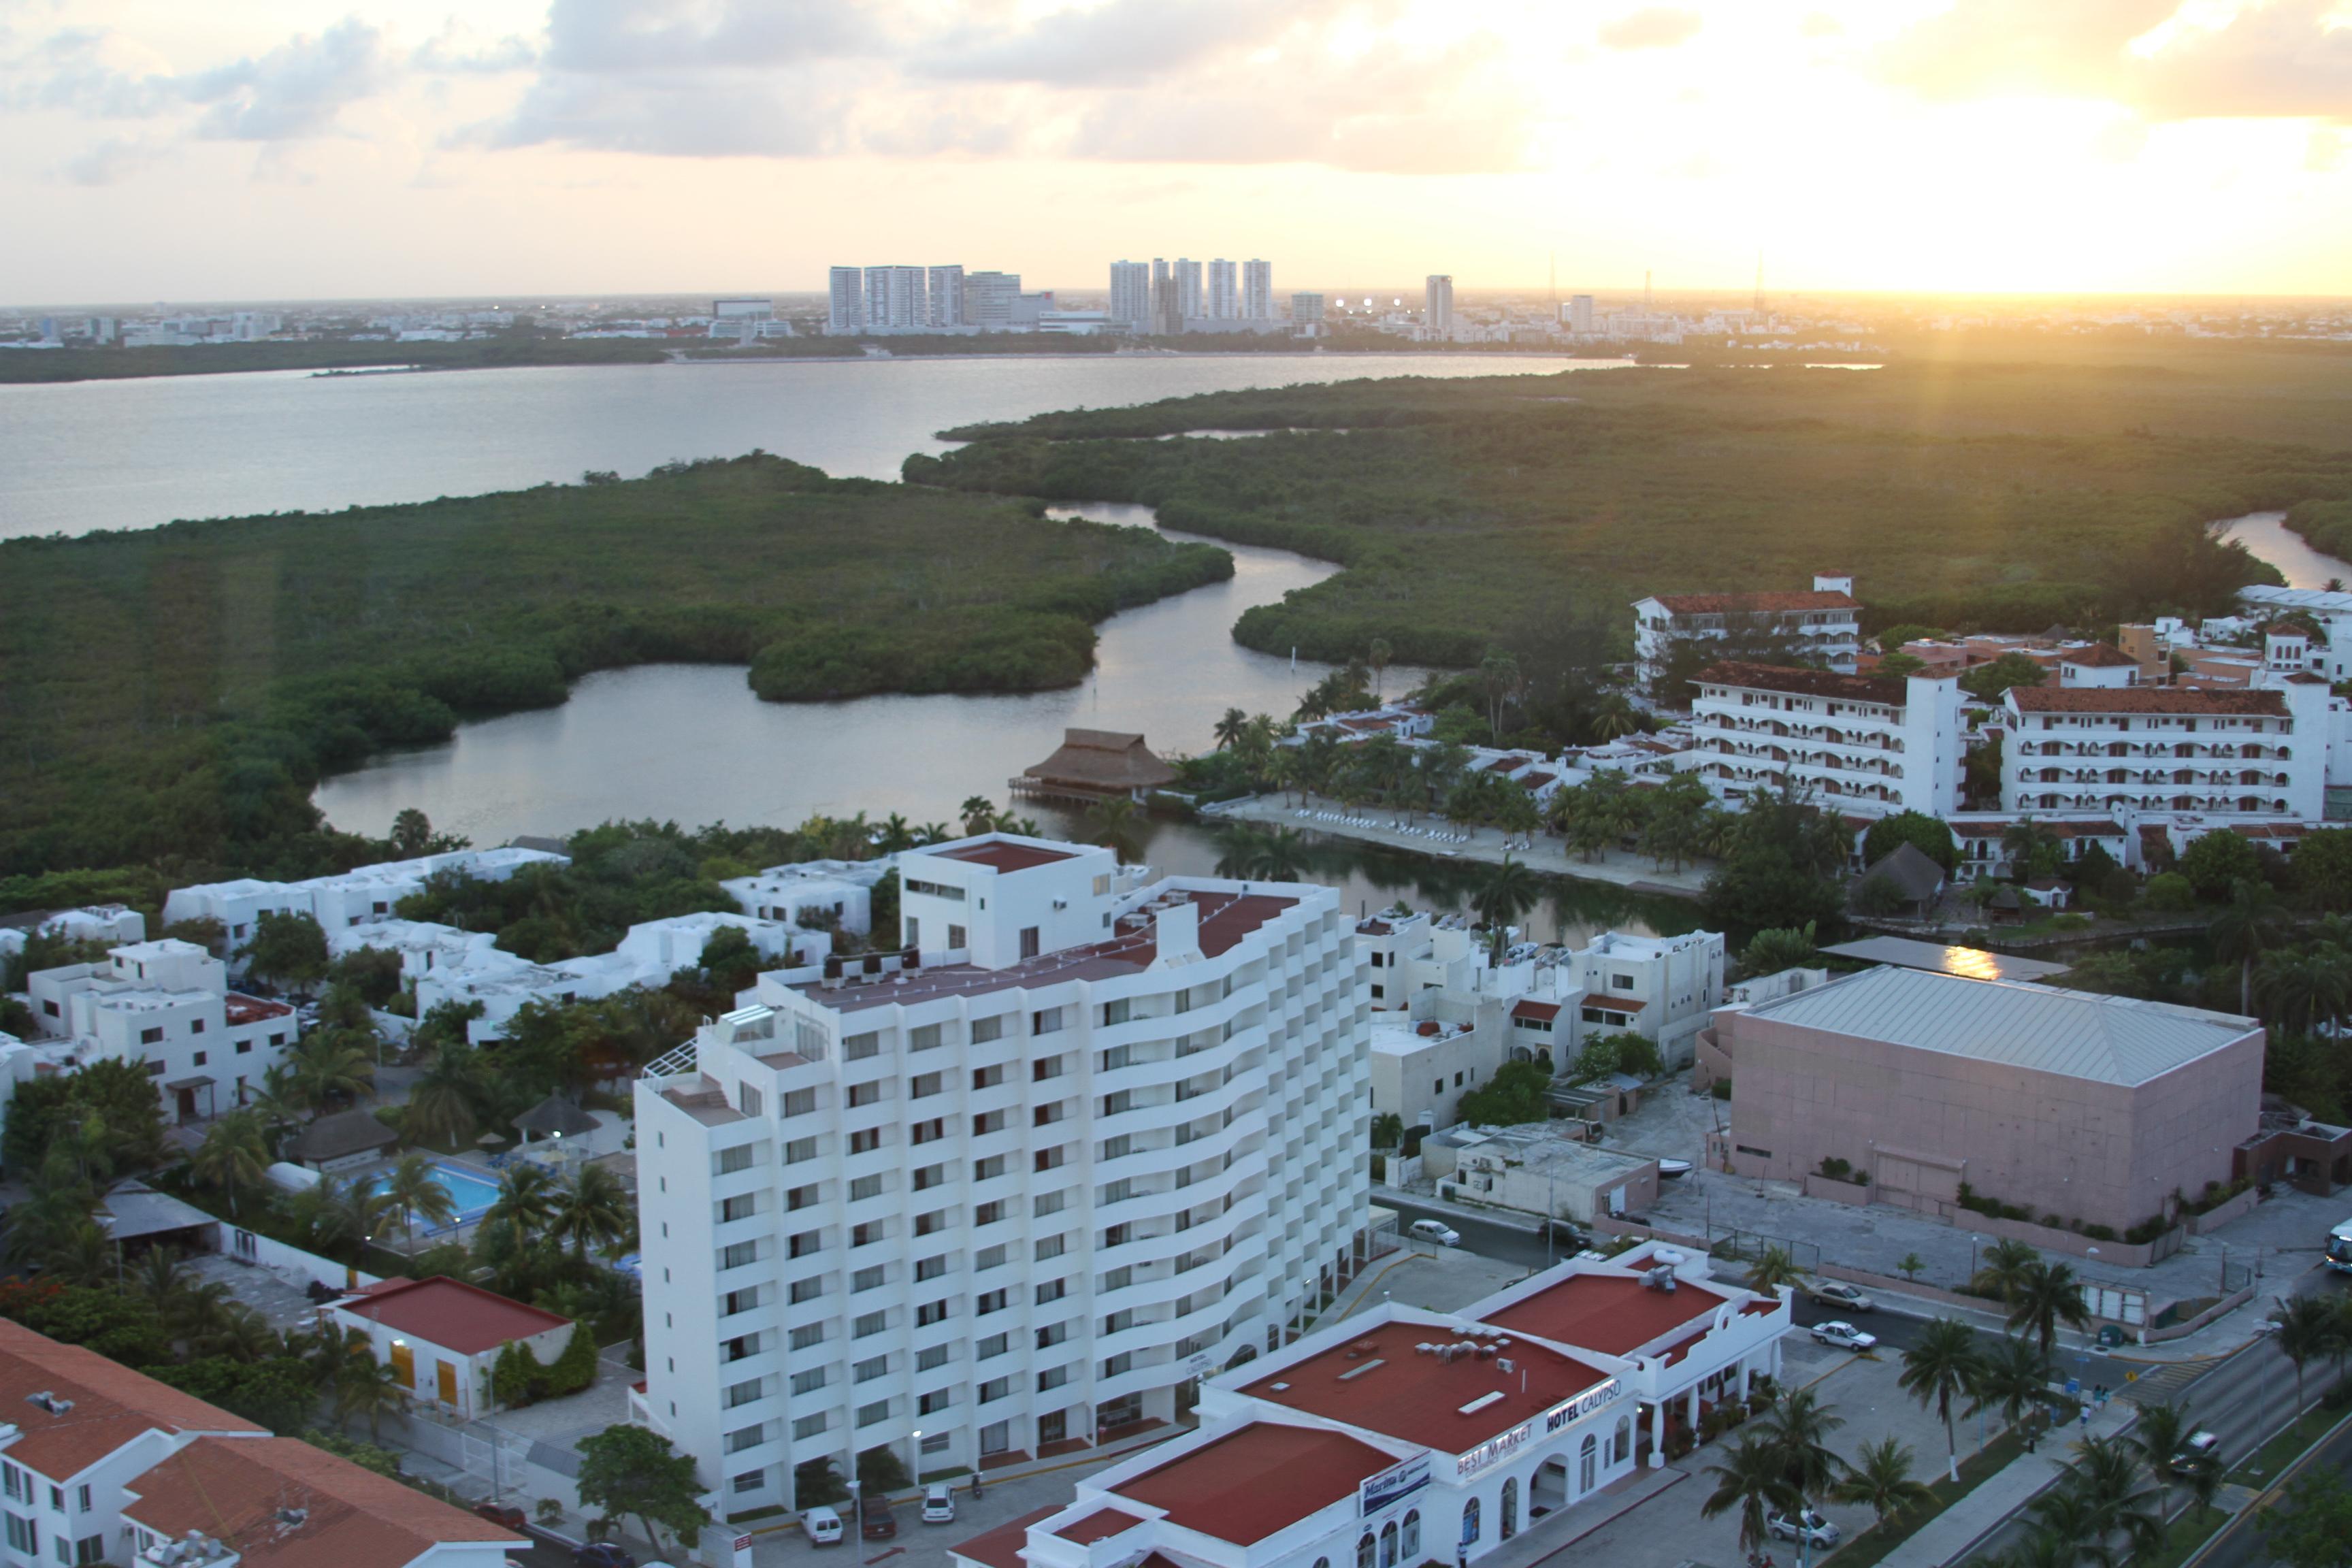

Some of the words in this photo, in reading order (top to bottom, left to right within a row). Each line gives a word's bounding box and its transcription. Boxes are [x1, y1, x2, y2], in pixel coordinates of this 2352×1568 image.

[1547, 1403, 1579, 1433] HOTEL
[1582, 1379, 1621, 1414] CALYPSO
[1457, 1450, 1482, 1475] BEST
[1488, 1422, 1532, 1459] MARKET
[1365, 1475, 1397, 1498] Marina
